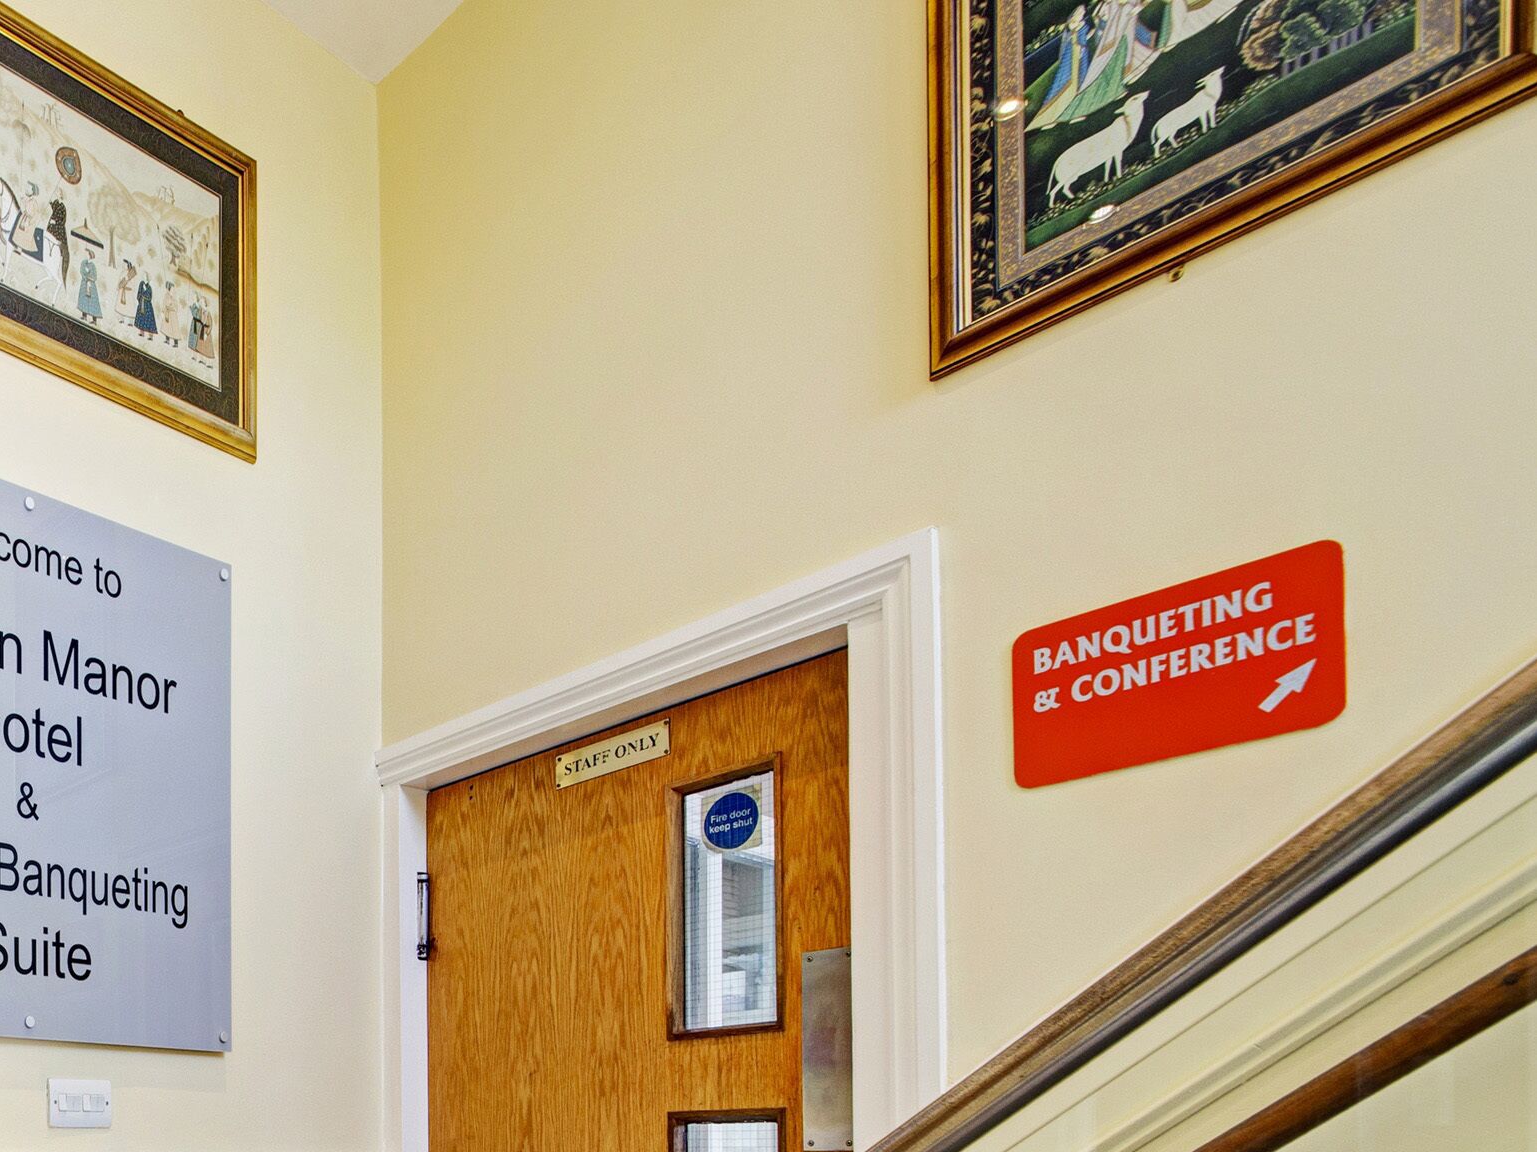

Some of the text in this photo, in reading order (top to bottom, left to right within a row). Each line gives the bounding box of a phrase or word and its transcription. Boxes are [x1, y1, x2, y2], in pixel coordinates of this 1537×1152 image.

[93, 558, 122, 598] to
[1033, 581, 1274, 676] BANQUETING
[43, 629, 177, 714] Manor
[1033, 613, 1317, 713] & CONFERENCE
[564, 732, 660, 776] STAFF ONLY
[16, 782, 40, 821] &
[710, 808, 751, 824] Fire door
[709, 817, 753, 834] keep shut
